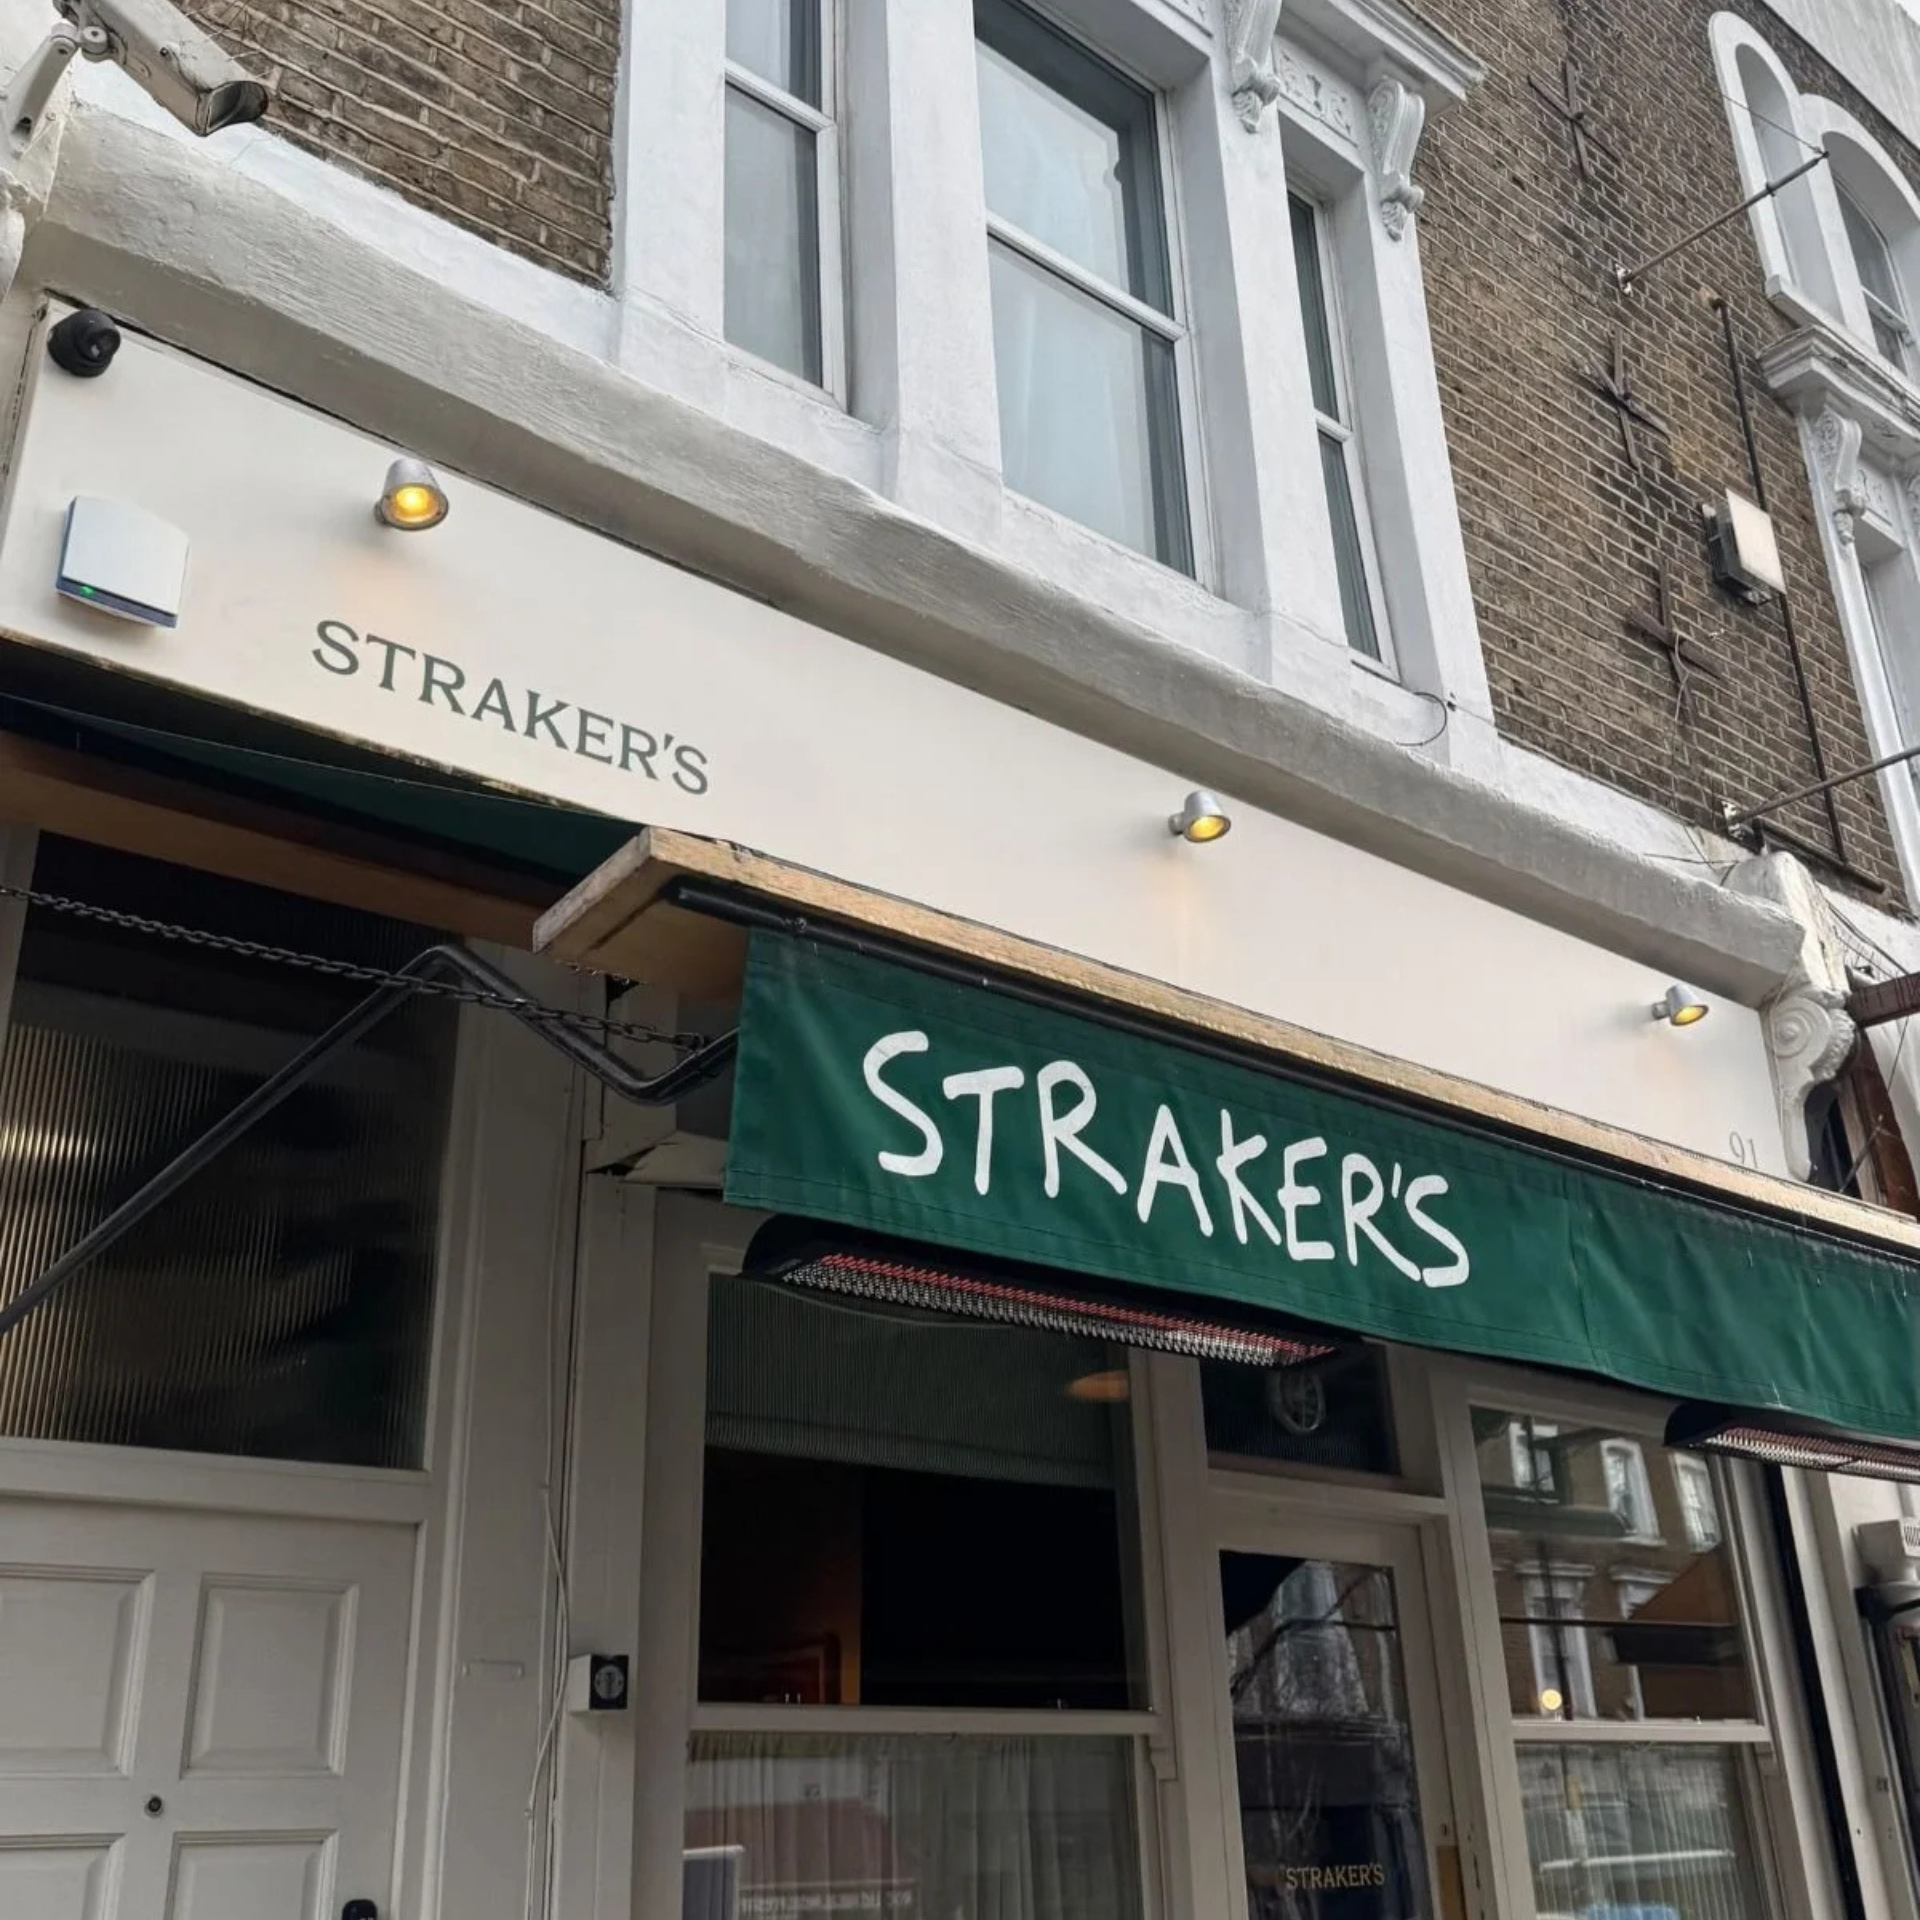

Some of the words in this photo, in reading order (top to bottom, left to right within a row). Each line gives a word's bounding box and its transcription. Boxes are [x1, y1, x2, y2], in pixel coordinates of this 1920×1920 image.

[311, 619, 709, 796] STRAKER'S
[862, 1030, 1470, 1288] STRAKER'S
[1729, 1131, 1758, 1169] 91
[1285, 1862, 1386, 1890] STRAKER'S
